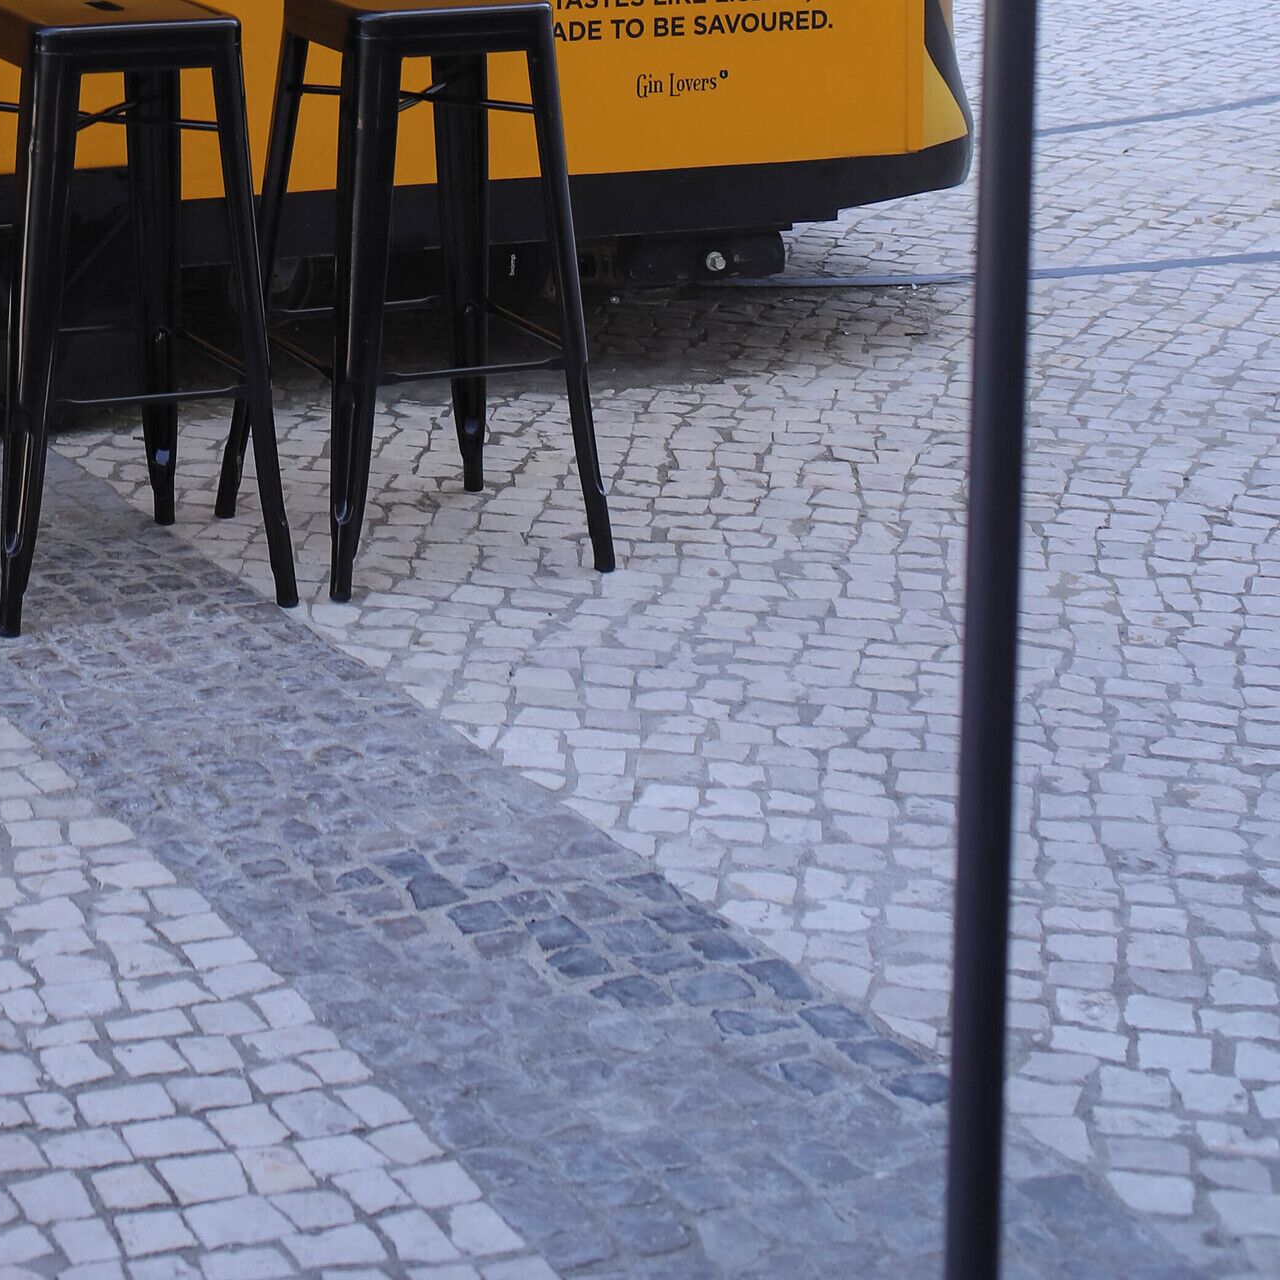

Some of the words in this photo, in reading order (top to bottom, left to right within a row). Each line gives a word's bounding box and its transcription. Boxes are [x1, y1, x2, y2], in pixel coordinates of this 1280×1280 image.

[553, 20, 602, 41] ADE
[611, 18, 645, 39] TO
[653, 16, 685, 38] BE
[694, 9, 834, 35] SAVOURED.
[636, 73, 664, 99] Gin
[669, 72, 717, 97] Lovers
